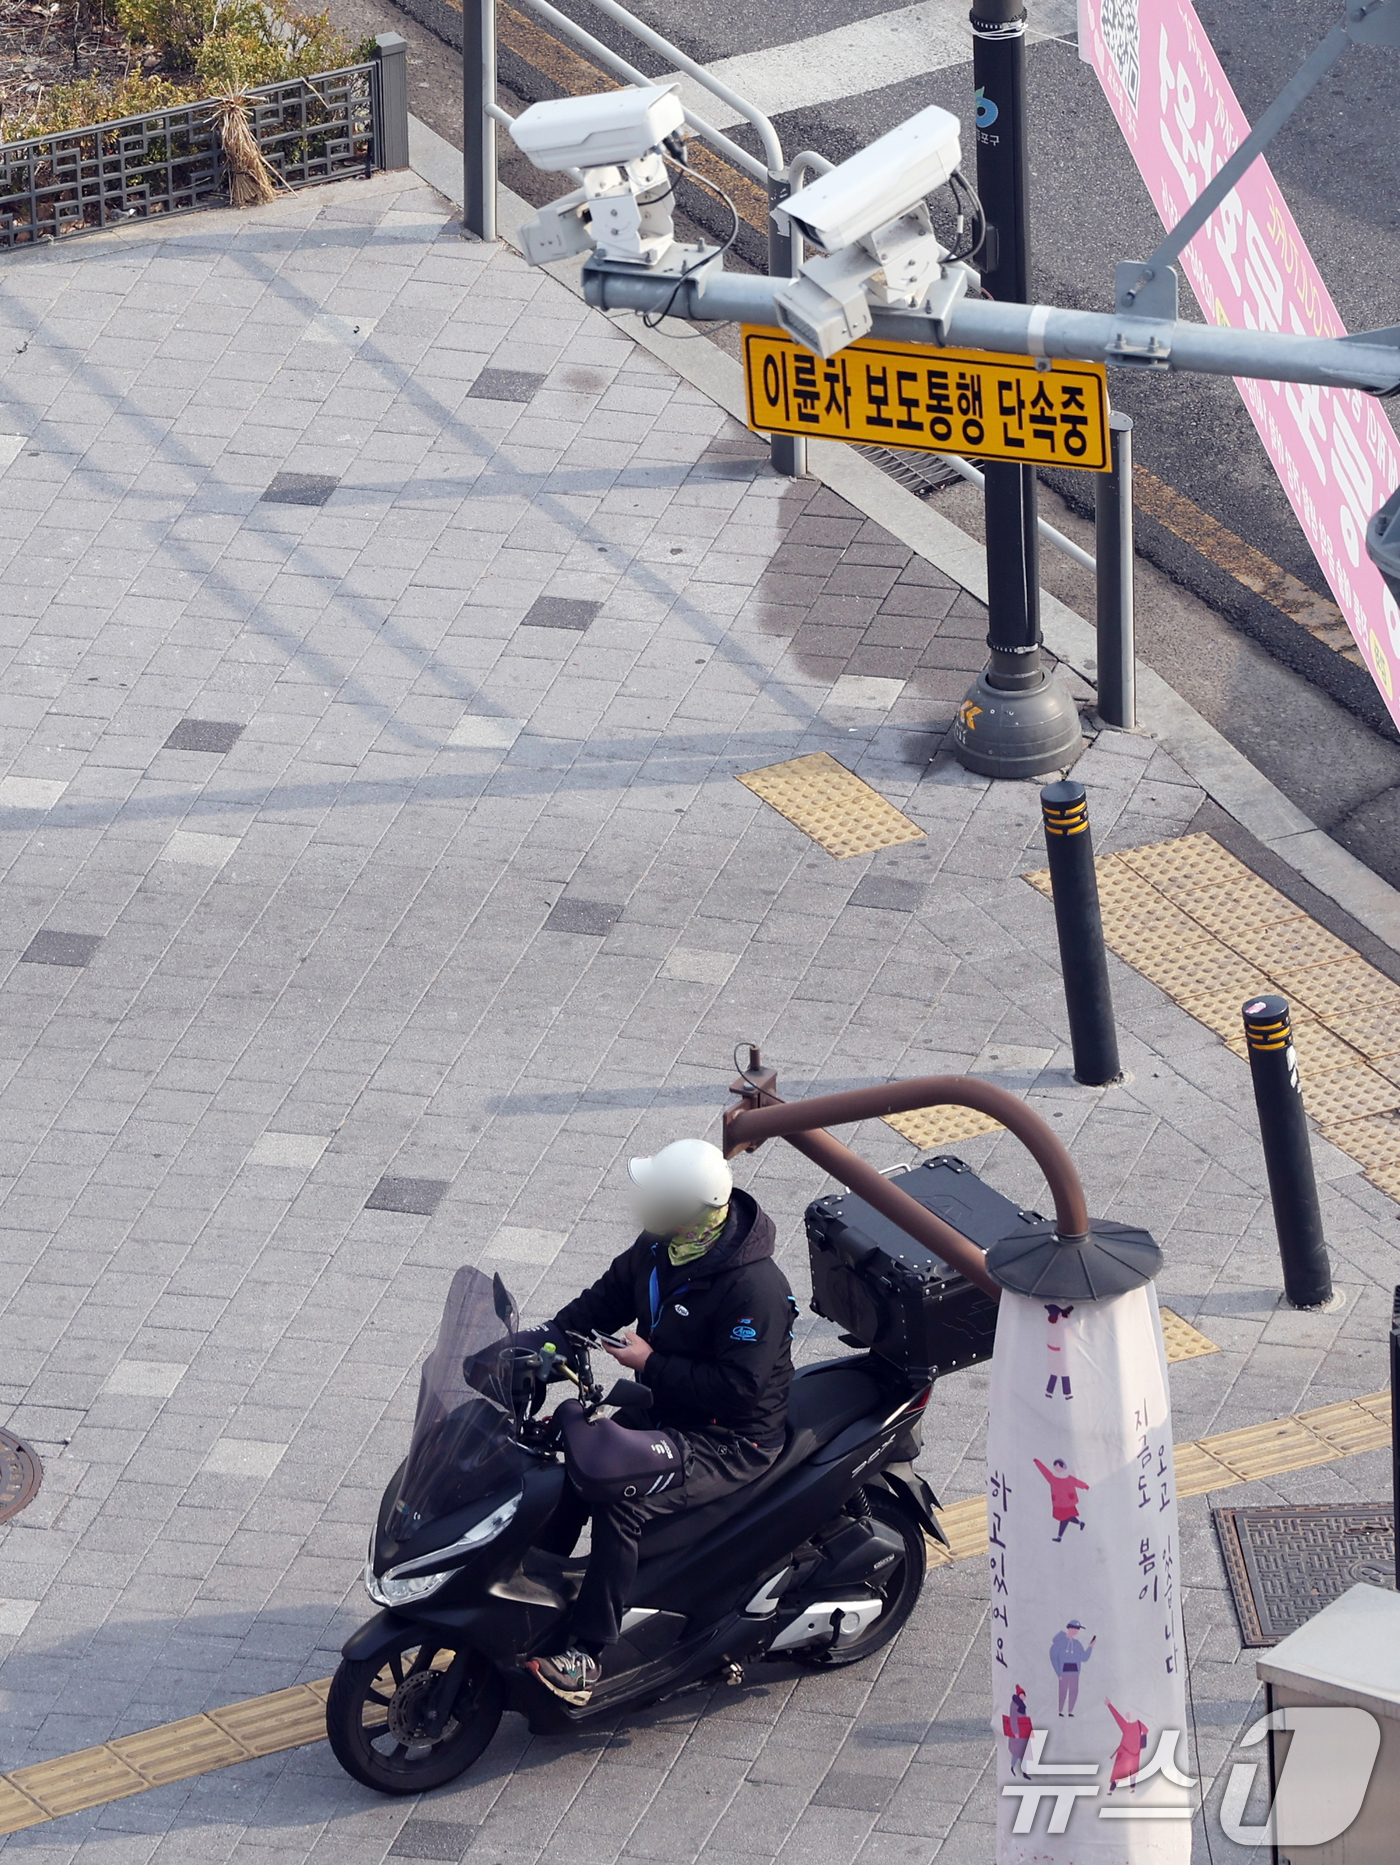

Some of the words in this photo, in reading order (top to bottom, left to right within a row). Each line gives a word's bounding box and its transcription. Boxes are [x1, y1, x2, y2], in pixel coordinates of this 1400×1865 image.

[763, 351, 851, 429] 이륜차
[866, 364, 984, 445] 보도통행
[998, 378, 1088, 456] 단속중
[1134, 1397, 1151, 1508] 지금도
[1157, 1444, 1171, 1512] 오고
[1138, 1537, 1158, 1602] 봄이
